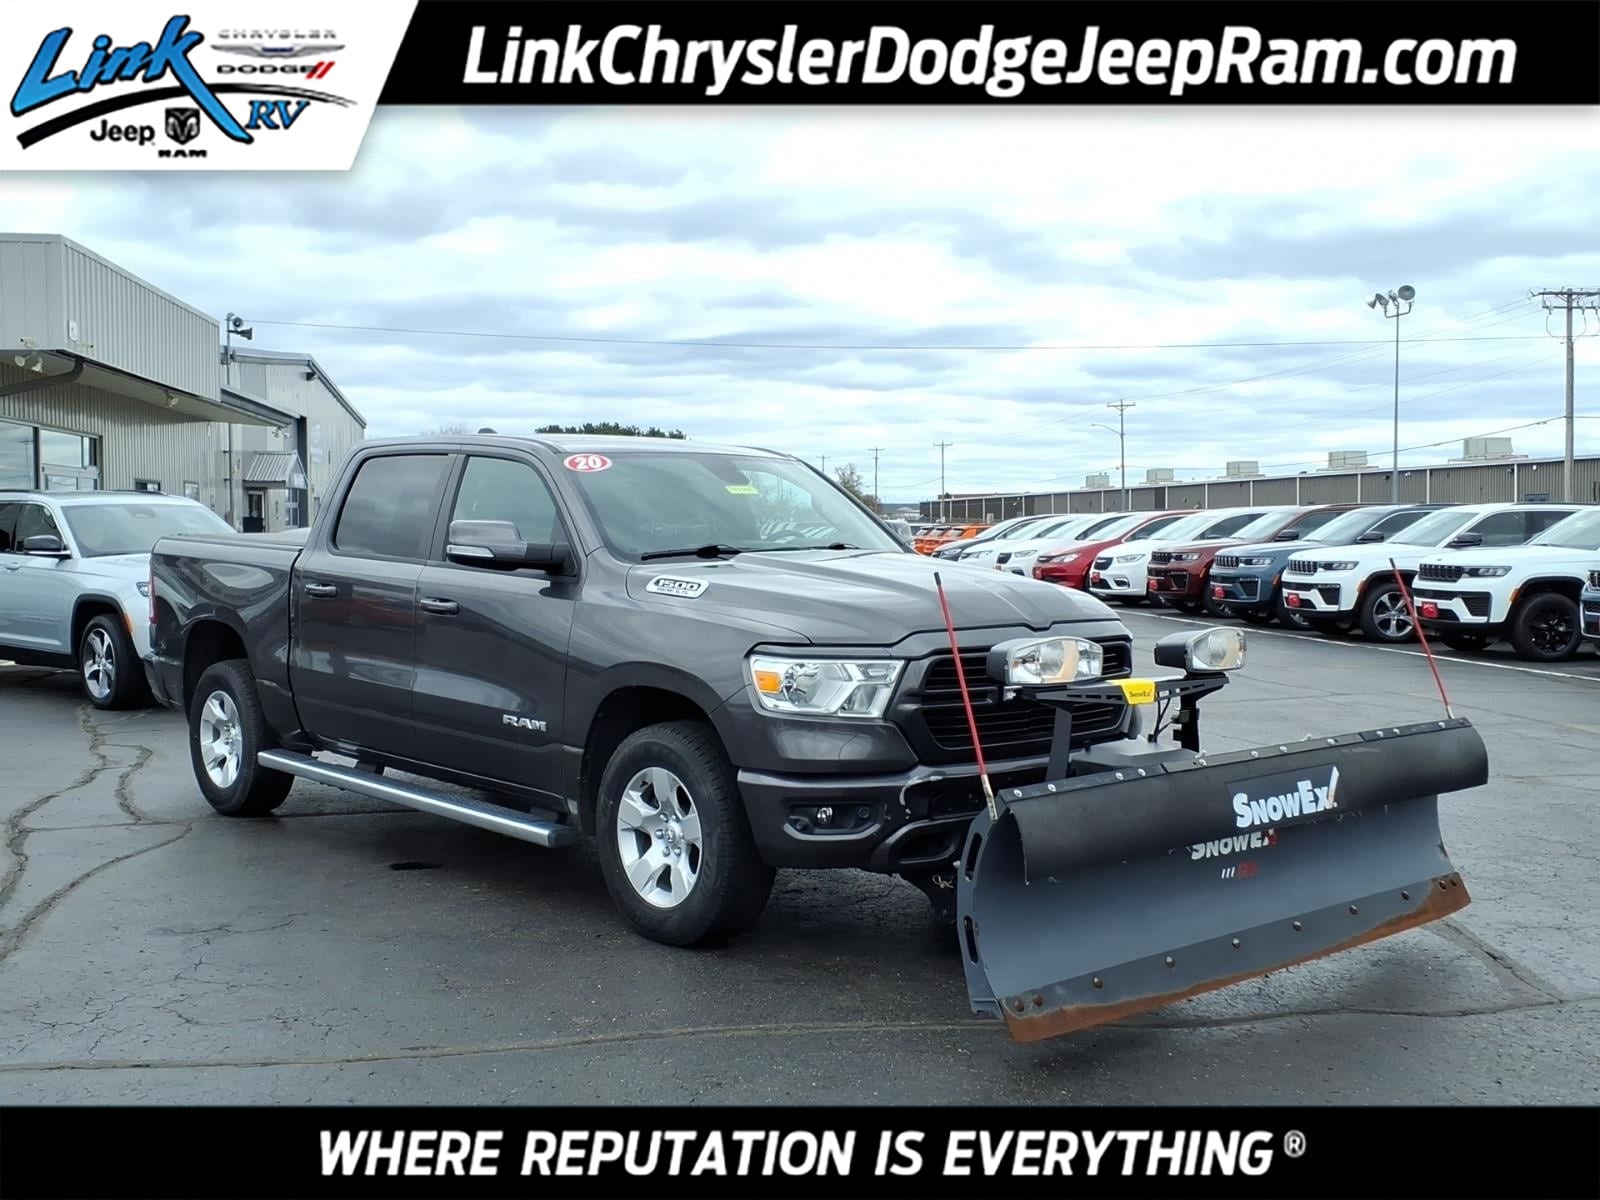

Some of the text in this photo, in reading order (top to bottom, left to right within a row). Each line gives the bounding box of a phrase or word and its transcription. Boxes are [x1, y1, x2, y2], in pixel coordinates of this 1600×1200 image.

[574, 455, 602, 469] 20
[659, 579, 700, 591] 1500
[502, 714, 547, 732] RAM
